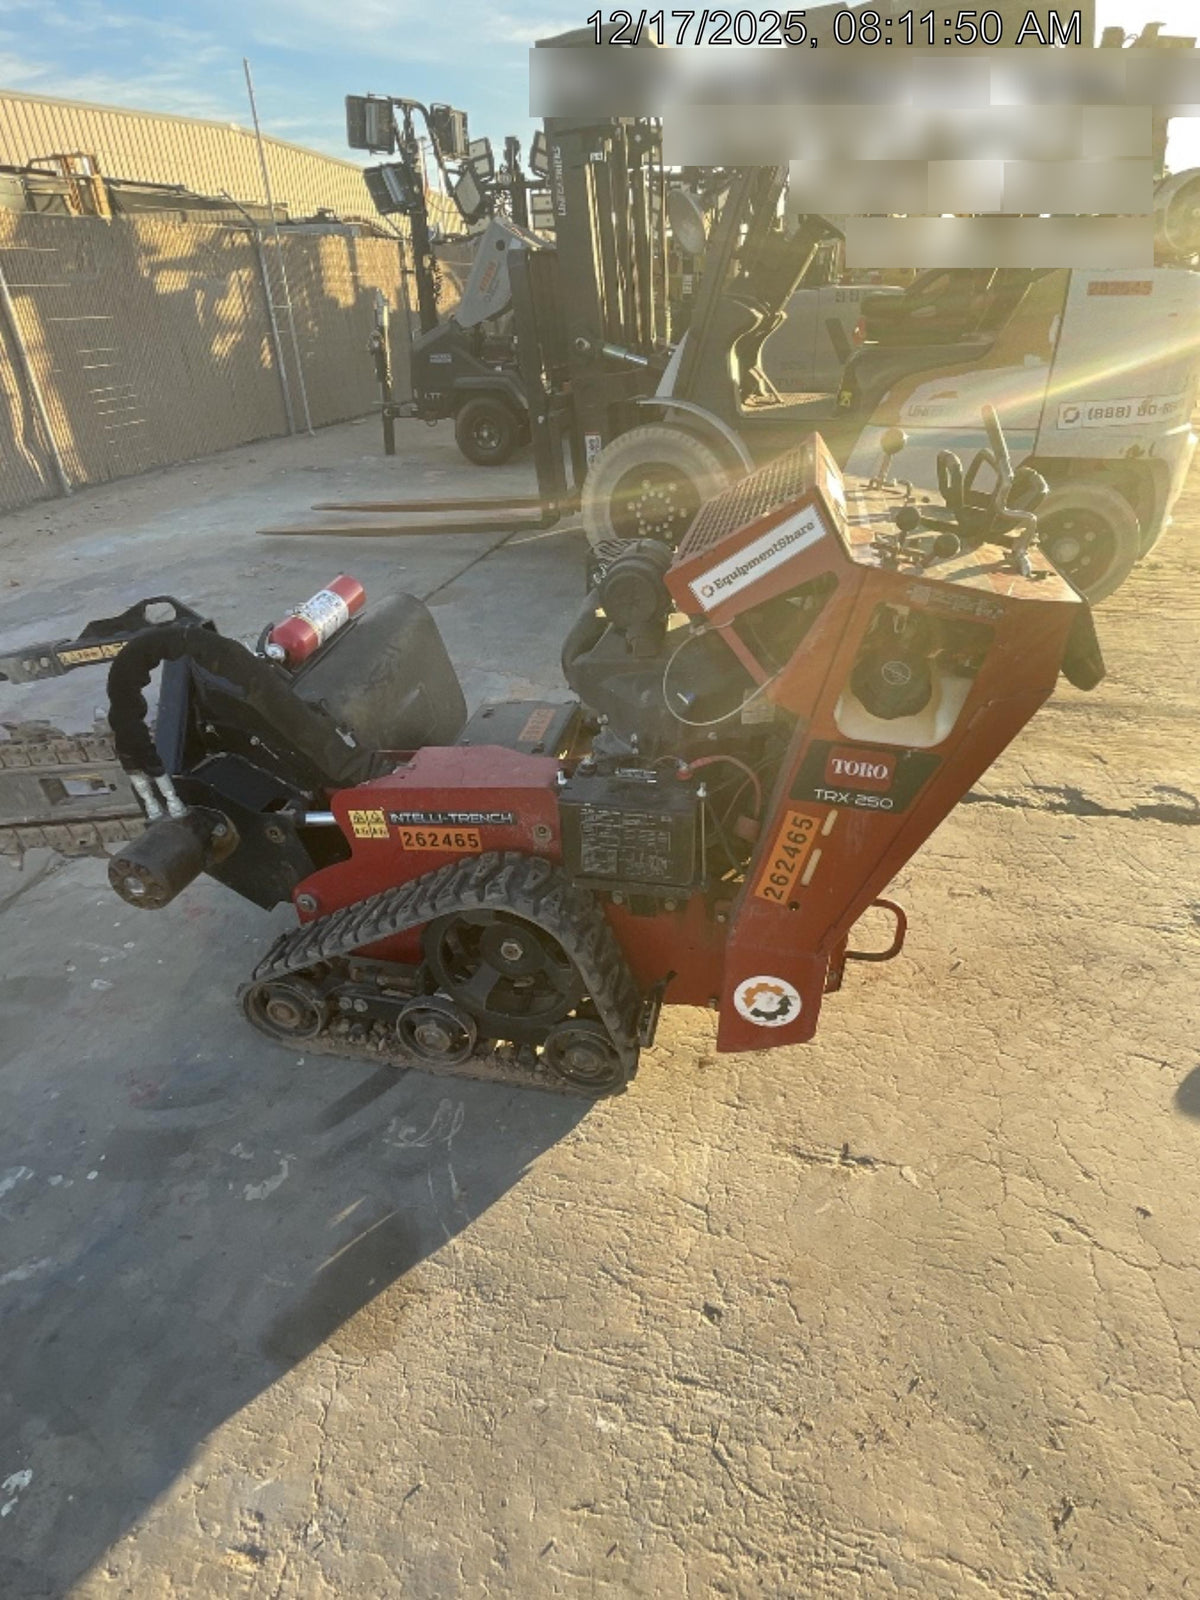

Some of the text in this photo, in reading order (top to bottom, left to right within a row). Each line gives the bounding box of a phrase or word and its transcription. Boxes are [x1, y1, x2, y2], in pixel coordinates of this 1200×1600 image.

[1088, 405, 1131, 420] (888)
[713, 520, 815, 591] EquipmentShare
[831, 758, 888, 780] TORO
[814, 788, 894, 809] TRX-250
[390, 812, 513, 825] INTELLI-TRENCH
[402, 831, 479, 848] 262465
[763, 815, 813, 900] 262465
